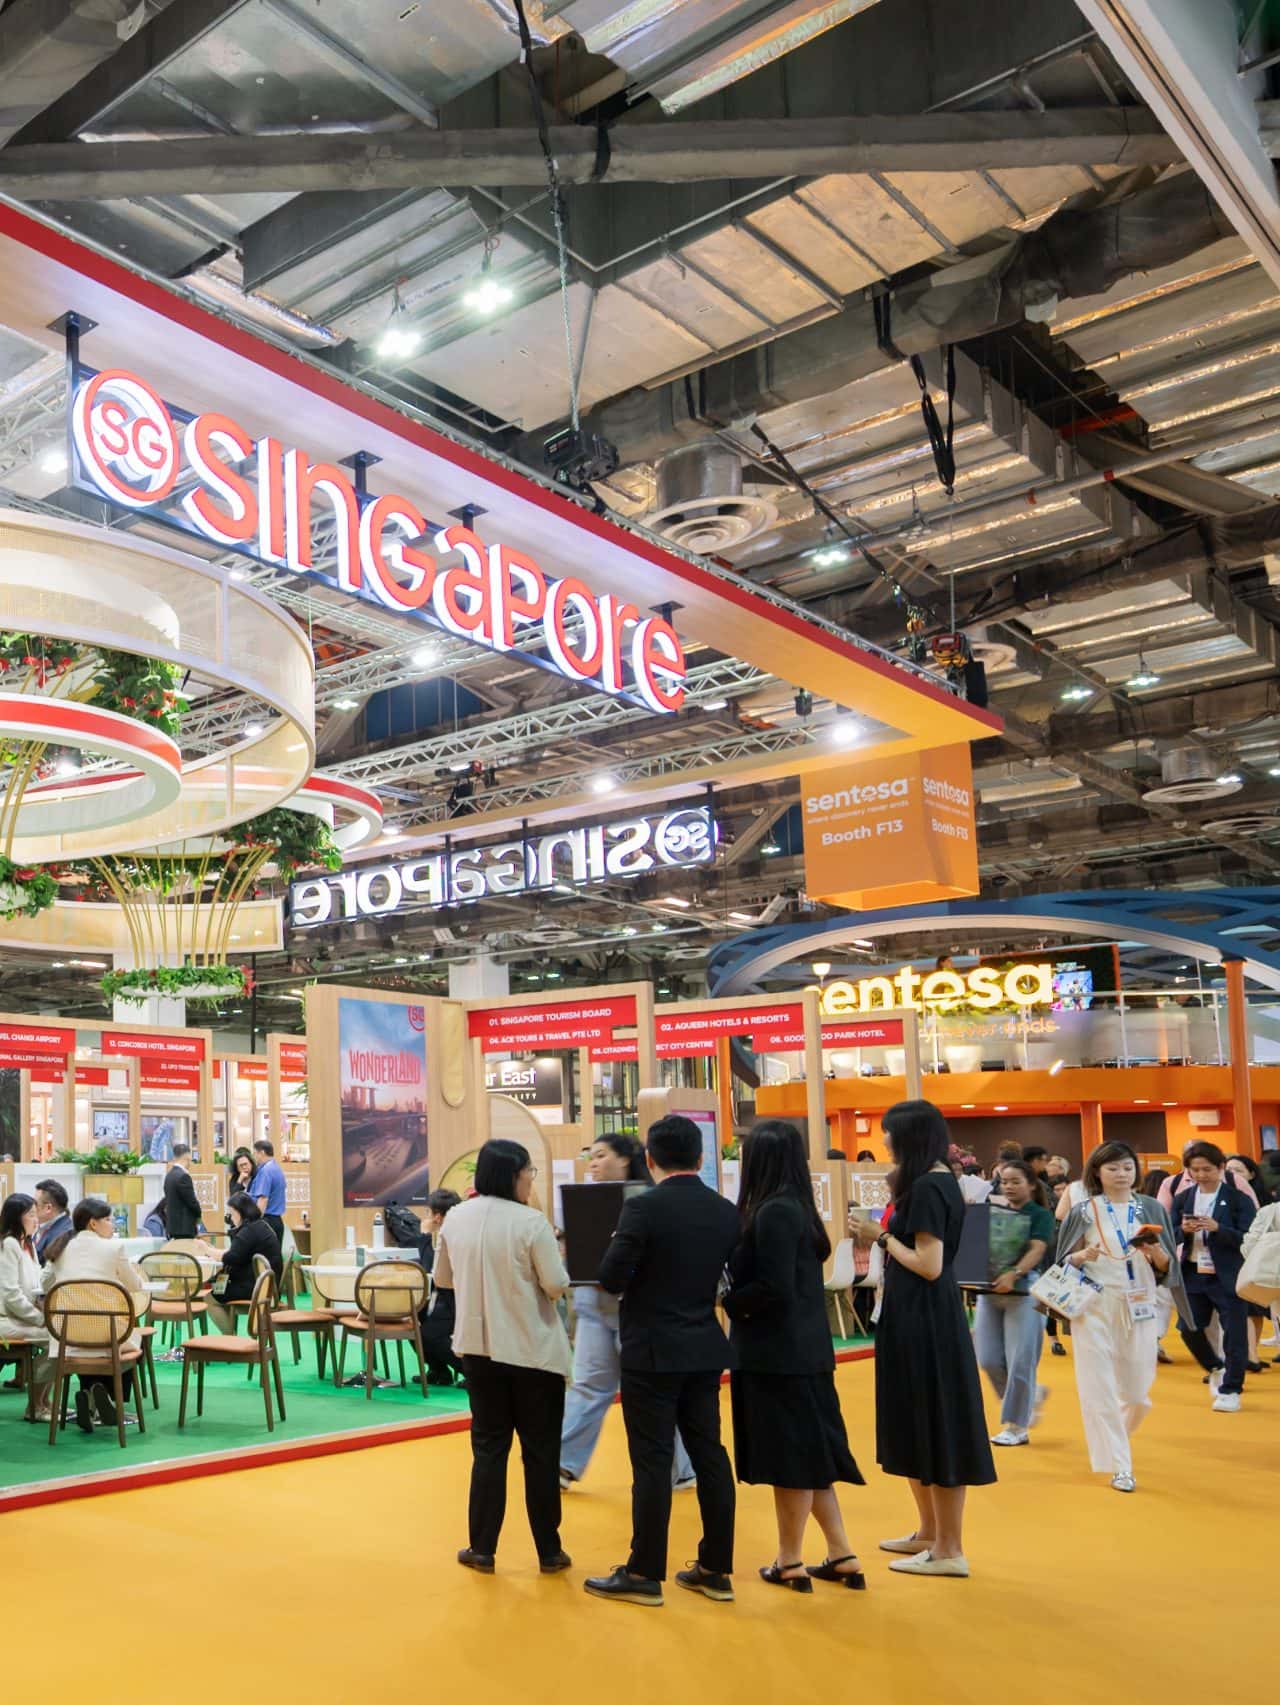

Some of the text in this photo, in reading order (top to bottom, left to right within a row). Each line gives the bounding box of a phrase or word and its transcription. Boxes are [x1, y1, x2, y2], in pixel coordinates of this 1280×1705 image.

[821, 819, 904, 846] Booth F13
[931, 818, 956, 836] Booth
[489, 1008, 612, 1027] 01. SINGAPORE TOURISM BOARD
[674, 1021, 708, 1031] AQUEEN
[710, 1018, 741, 1028] HOTELS
[743, 1017, 750, 1025] &
[751, 1014, 789, 1024] RESORTS
[516, 1033, 538, 1043] TOURS
[544, 1031, 570, 1040] TRAVEL
[572, 1030, 586, 1038] PTE
[586, 1029, 601, 1037] LTD
[834, 1031, 857, 1040] PARK
[857, 1030, 885, 1038] HOTEL
[670, 1042, 686, 1050] CITY
[686, 1041, 714, 1049] CENTRE
[349, 1049, 421, 1085] WONDERLAND
[501, 1067, 536, 1086] East
